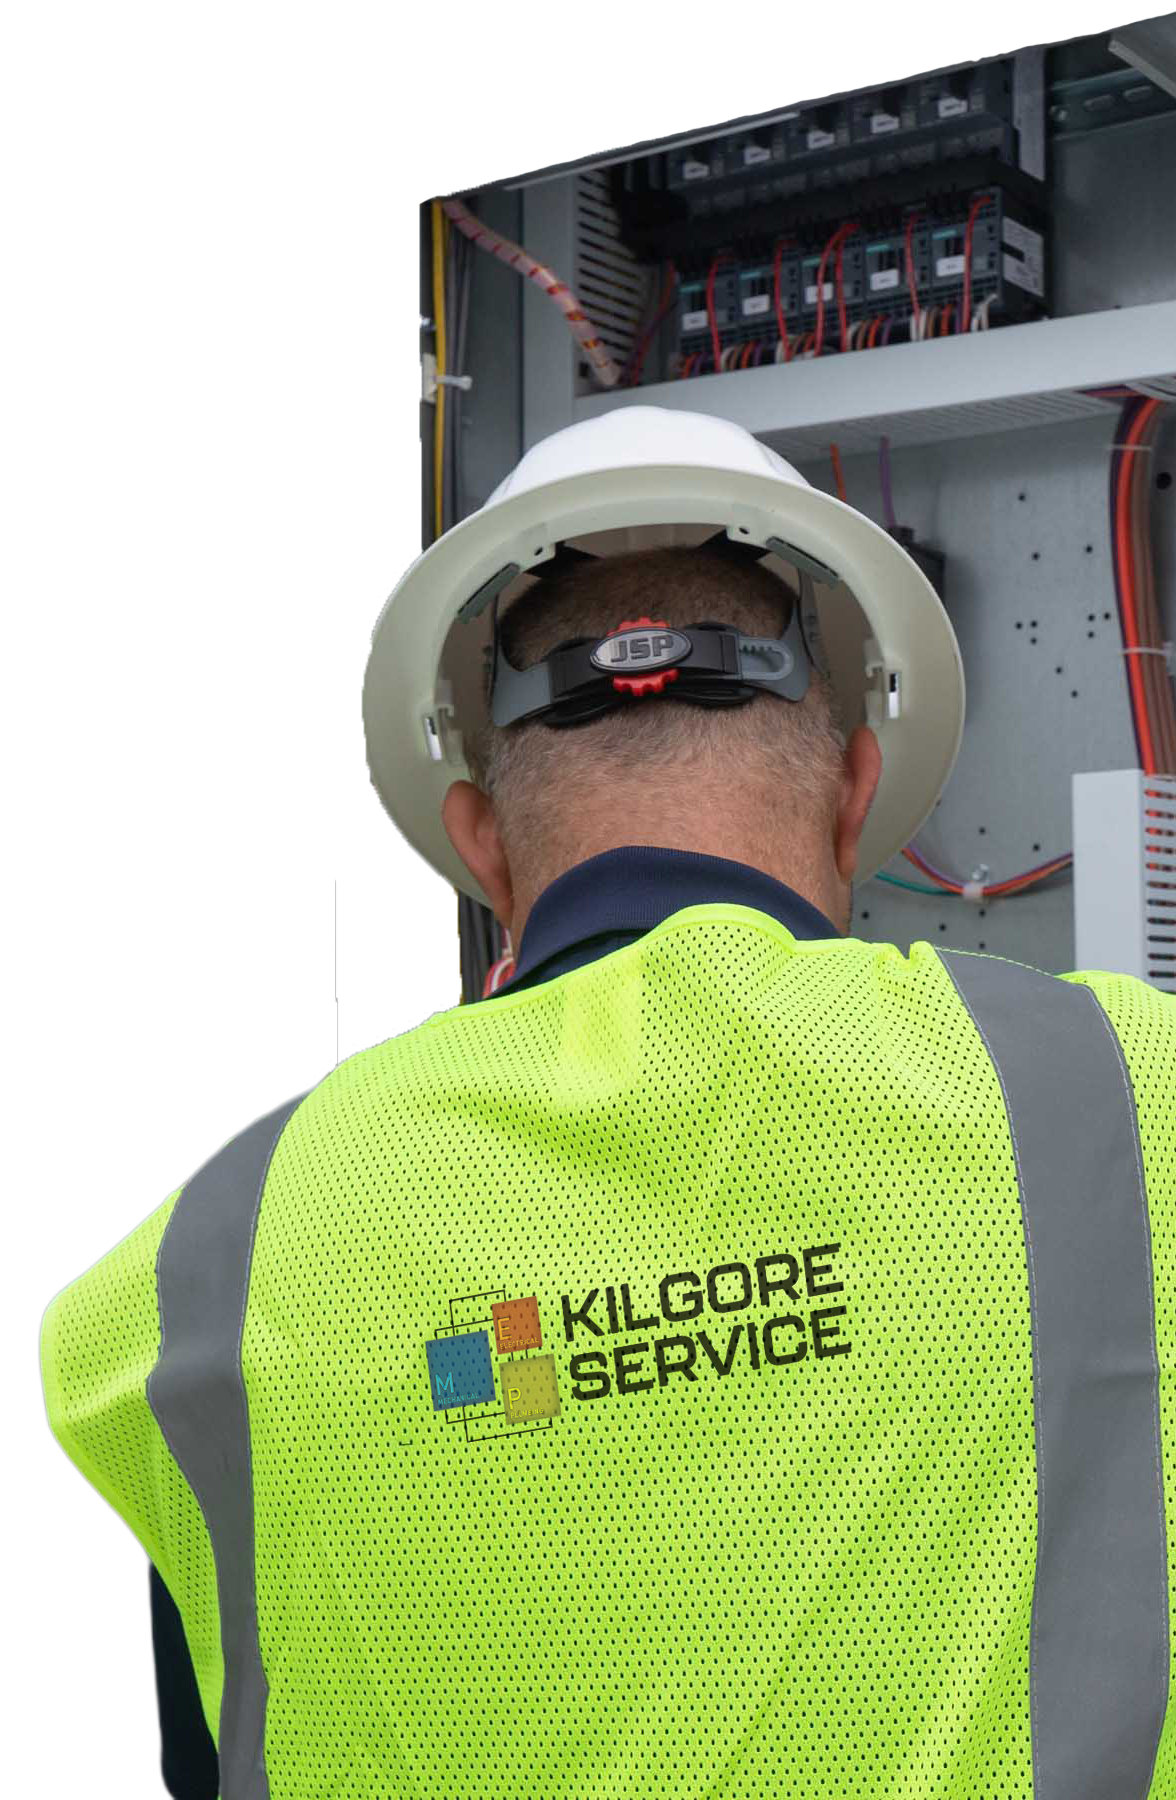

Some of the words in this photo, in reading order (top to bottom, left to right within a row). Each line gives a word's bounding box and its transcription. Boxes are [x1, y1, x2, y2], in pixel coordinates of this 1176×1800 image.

[611, 635, 674, 662] JSP
[560, 1243, 844, 1342] KILGORE
[497, 1317, 512, 1341] E
[500, 1337, 540, 1350] ELECTRICAL
[568, 1305, 852, 1401] SERVICE
[435, 1372, 455, 1396] M
[437, 1393, 480, 1405] MECHANICAL
[508, 1387, 522, 1410] P
[511, 1408, 544, 1419] PLUMBING
